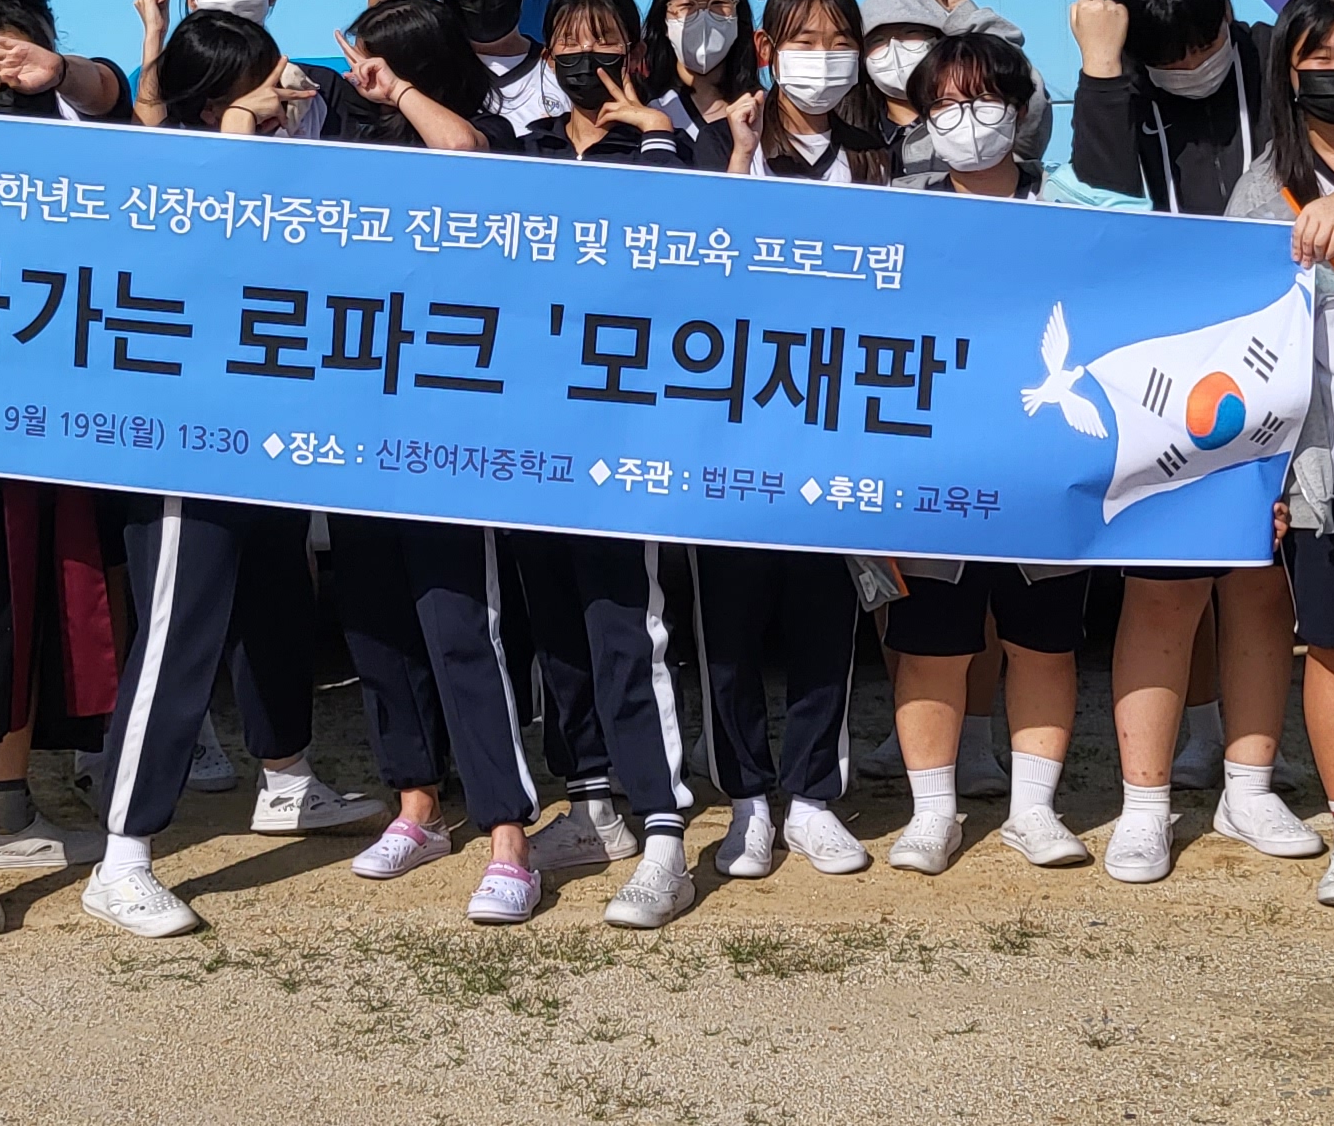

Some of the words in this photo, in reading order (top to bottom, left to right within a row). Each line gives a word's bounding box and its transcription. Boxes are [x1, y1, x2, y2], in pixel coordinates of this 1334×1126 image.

[119, 184, 394, 248] 신창여자중학교
[404, 206, 558, 262] 진로체험
[572, 218, 609, 266] 및
[622, 222, 740, 277] 법교육
[747, 236, 905, 290] 프로그램
[225, 284, 505, 395] 로파크
[550, 303, 971, 438] '모의재판'
[4, 404, 47, 438] 9월
[60, 411, 166, 451] 19일(월)
[177, 424, 250, 455] 13:30
[375, 438, 575, 484] 신창여자중학교
[702, 465, 786, 505] 법무부
[913, 485, 1002, 520] 교육부
